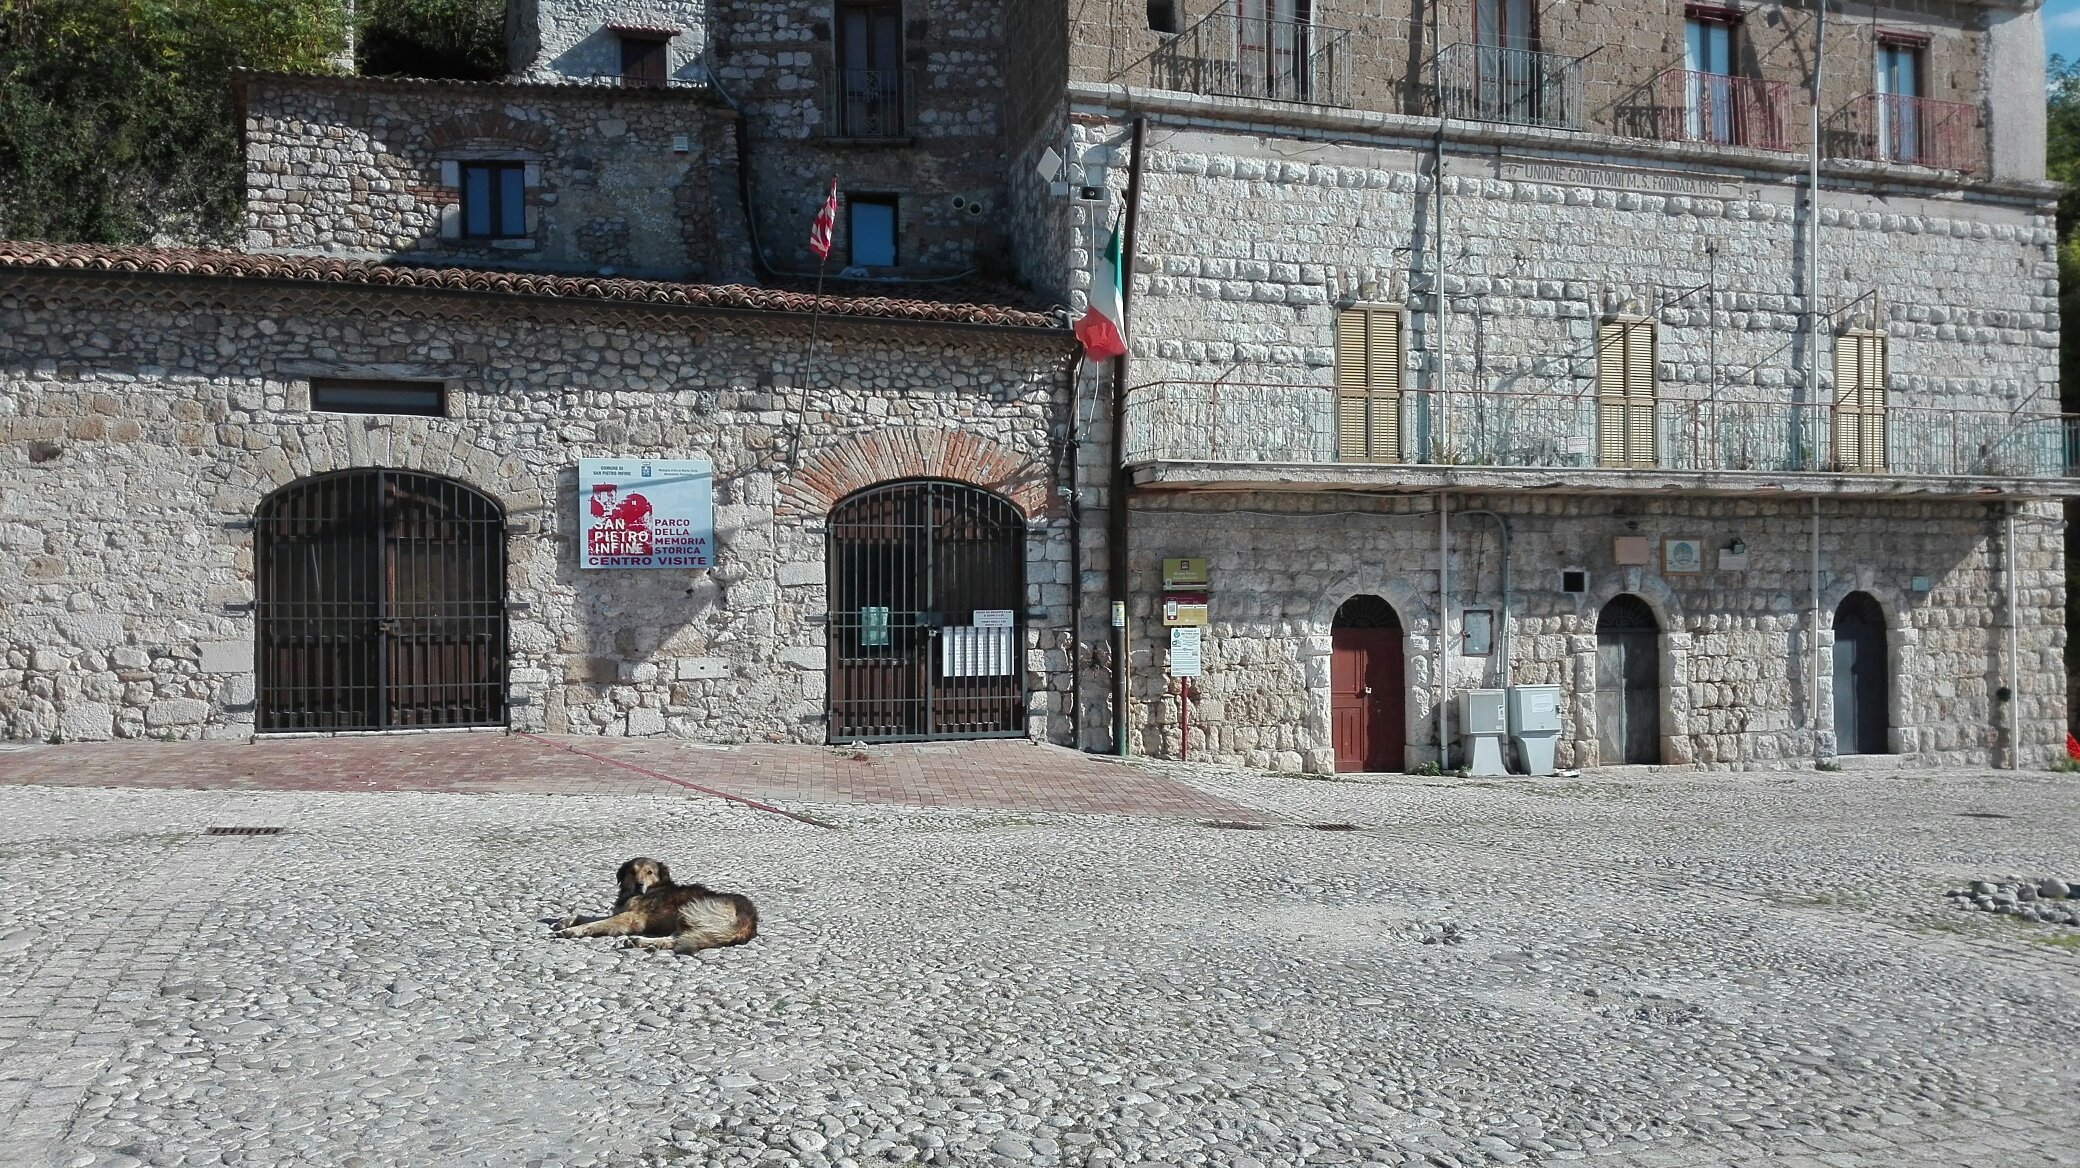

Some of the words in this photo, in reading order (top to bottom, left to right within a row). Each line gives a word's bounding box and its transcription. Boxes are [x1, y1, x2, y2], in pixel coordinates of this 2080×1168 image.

[1524, 164, 1566, 182] UNIONE
[1568, 168, 1624, 188] CONTADINI
[1627, 173, 1640, 190] M.
[1641, 175, 1650, 190] S.
[1653, 176, 1697, 194] FONDATA
[594, 518, 625, 530] SAN
[655, 519, 690, 527] PARCO
[594, 531, 649, 542] PIETRO
[655, 528, 690, 536] DELLA
[655, 537, 706, 545] MEMORIA
[595, 542, 644, 554] INFINE
[655, 546, 701, 554] STORICA
[588, 557, 652, 566] CENTRO
[657, 556, 707, 565] VISITE
